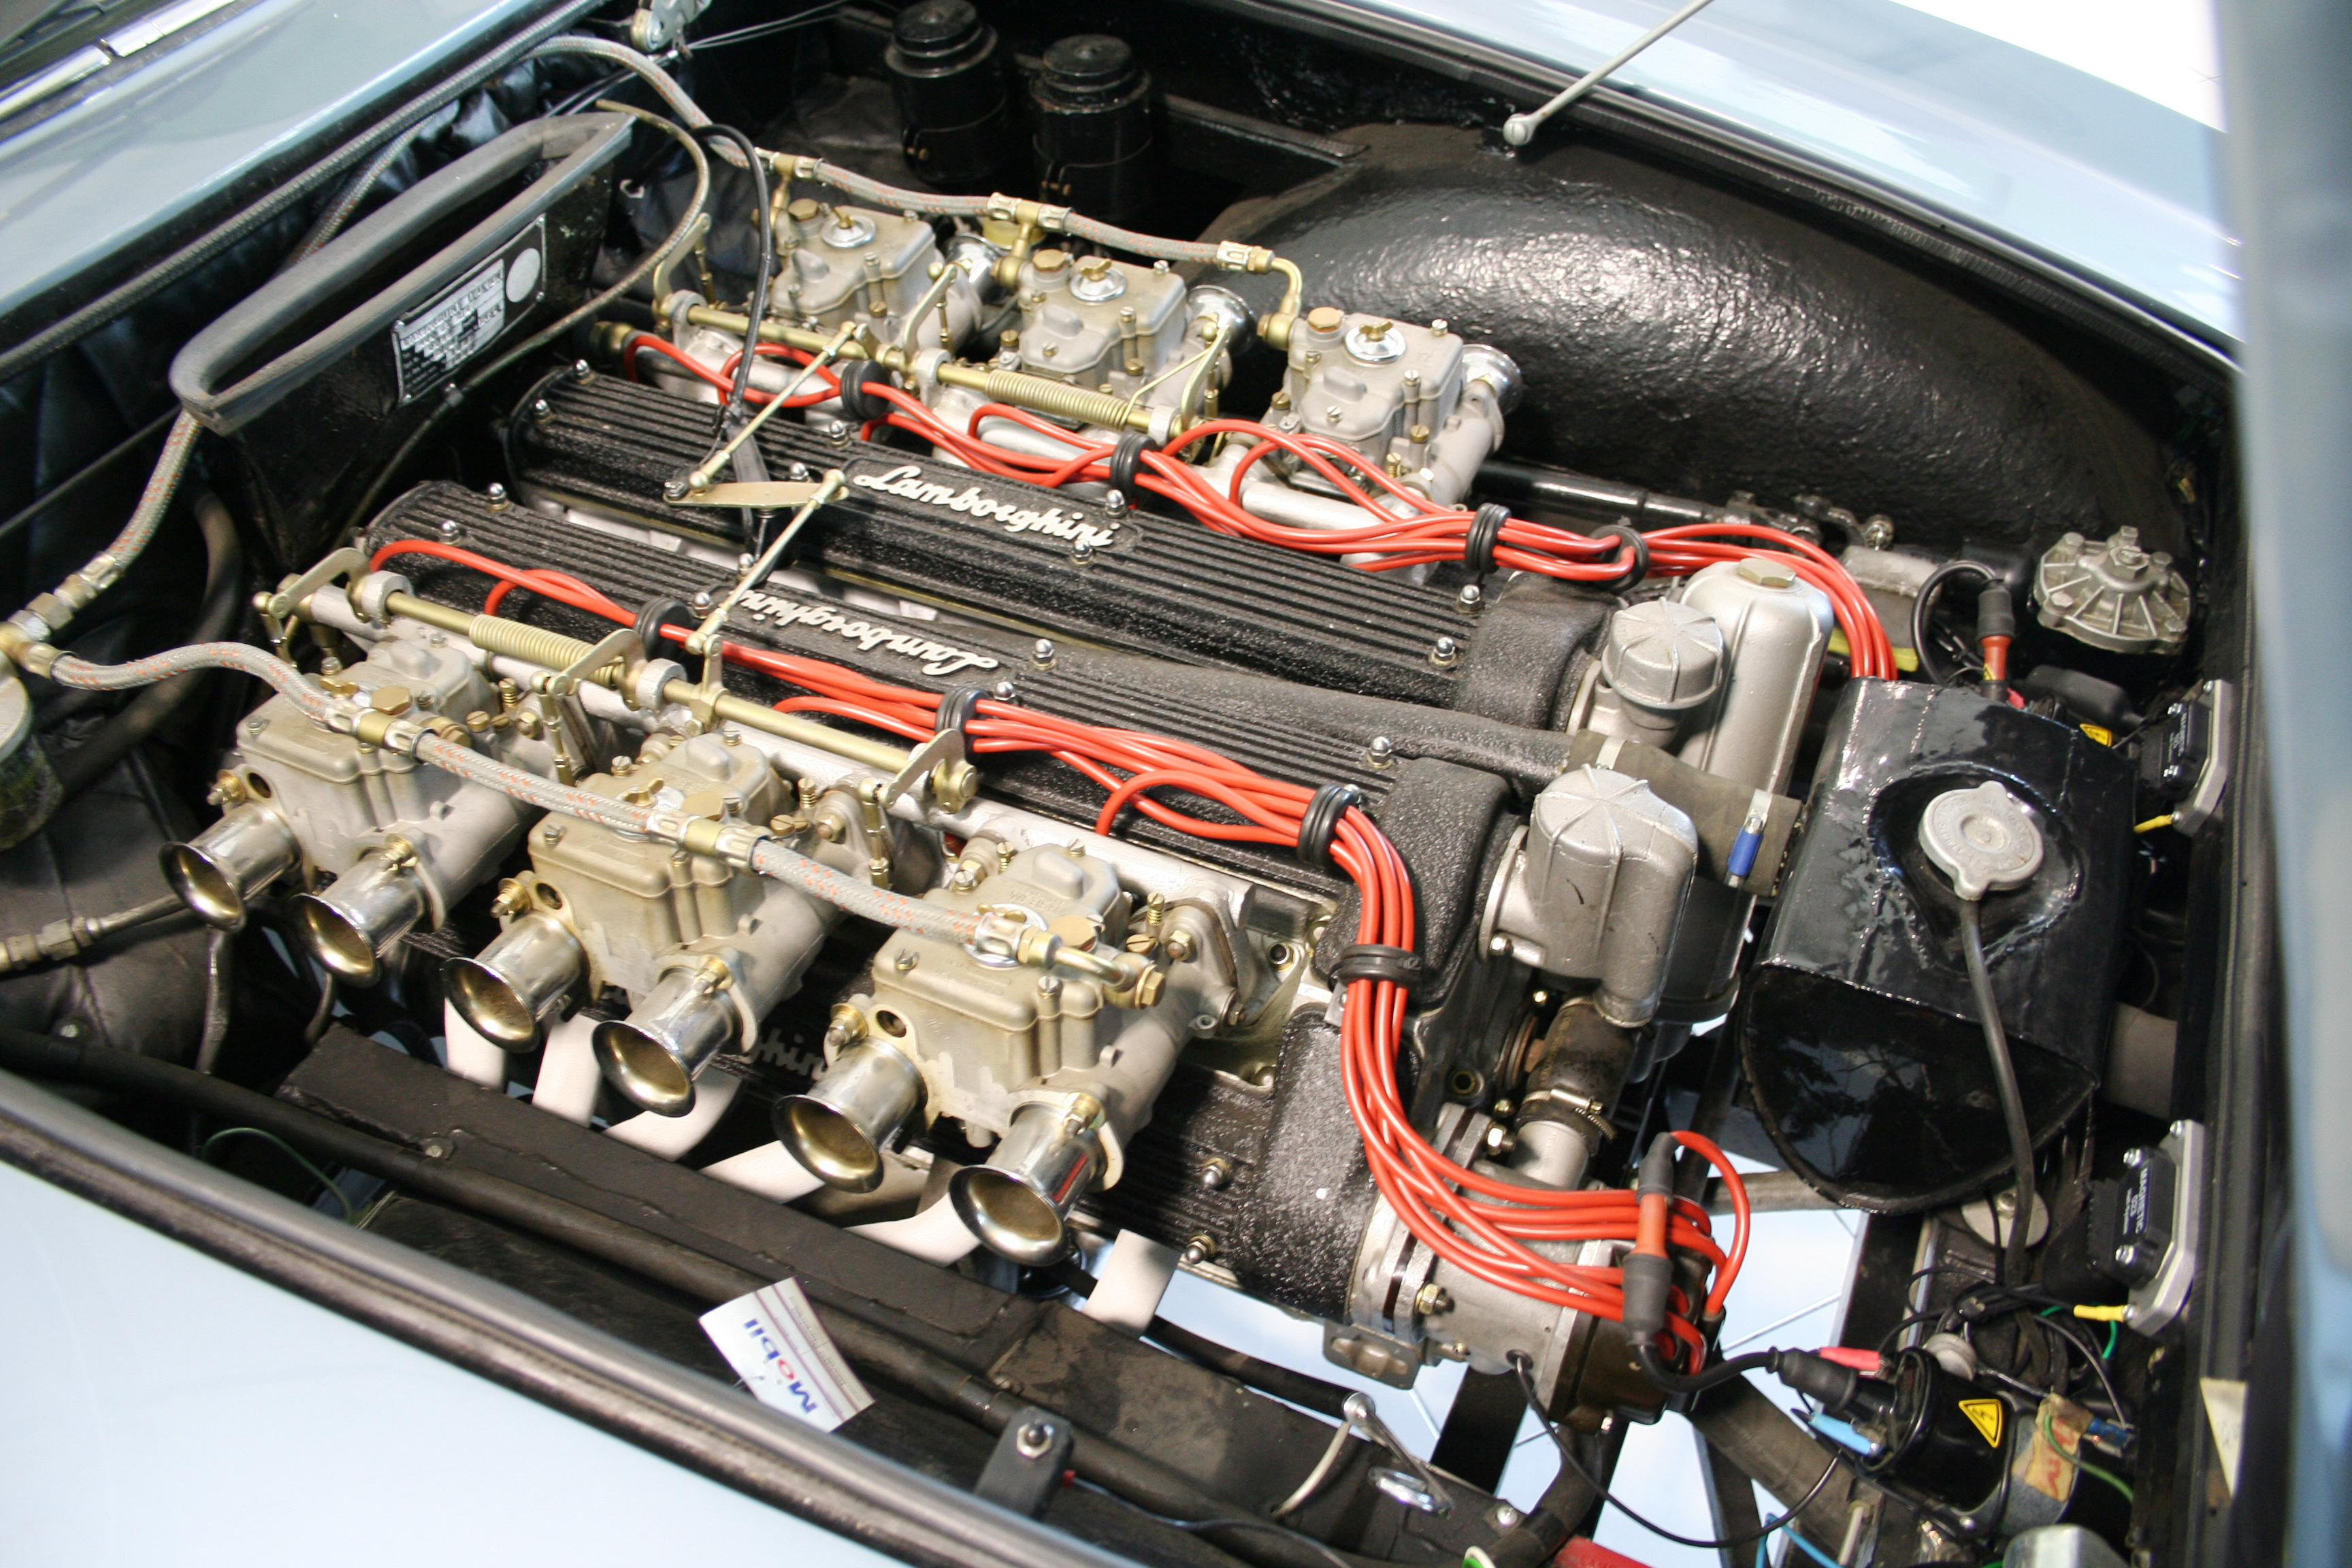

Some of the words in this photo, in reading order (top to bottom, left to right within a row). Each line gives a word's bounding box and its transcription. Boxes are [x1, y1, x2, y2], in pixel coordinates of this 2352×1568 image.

[853, 466, 1120, 546] Lamborghini
[719, 588, 998, 676] Lamborghin
[743, 1318, 818, 1414] Mobil
